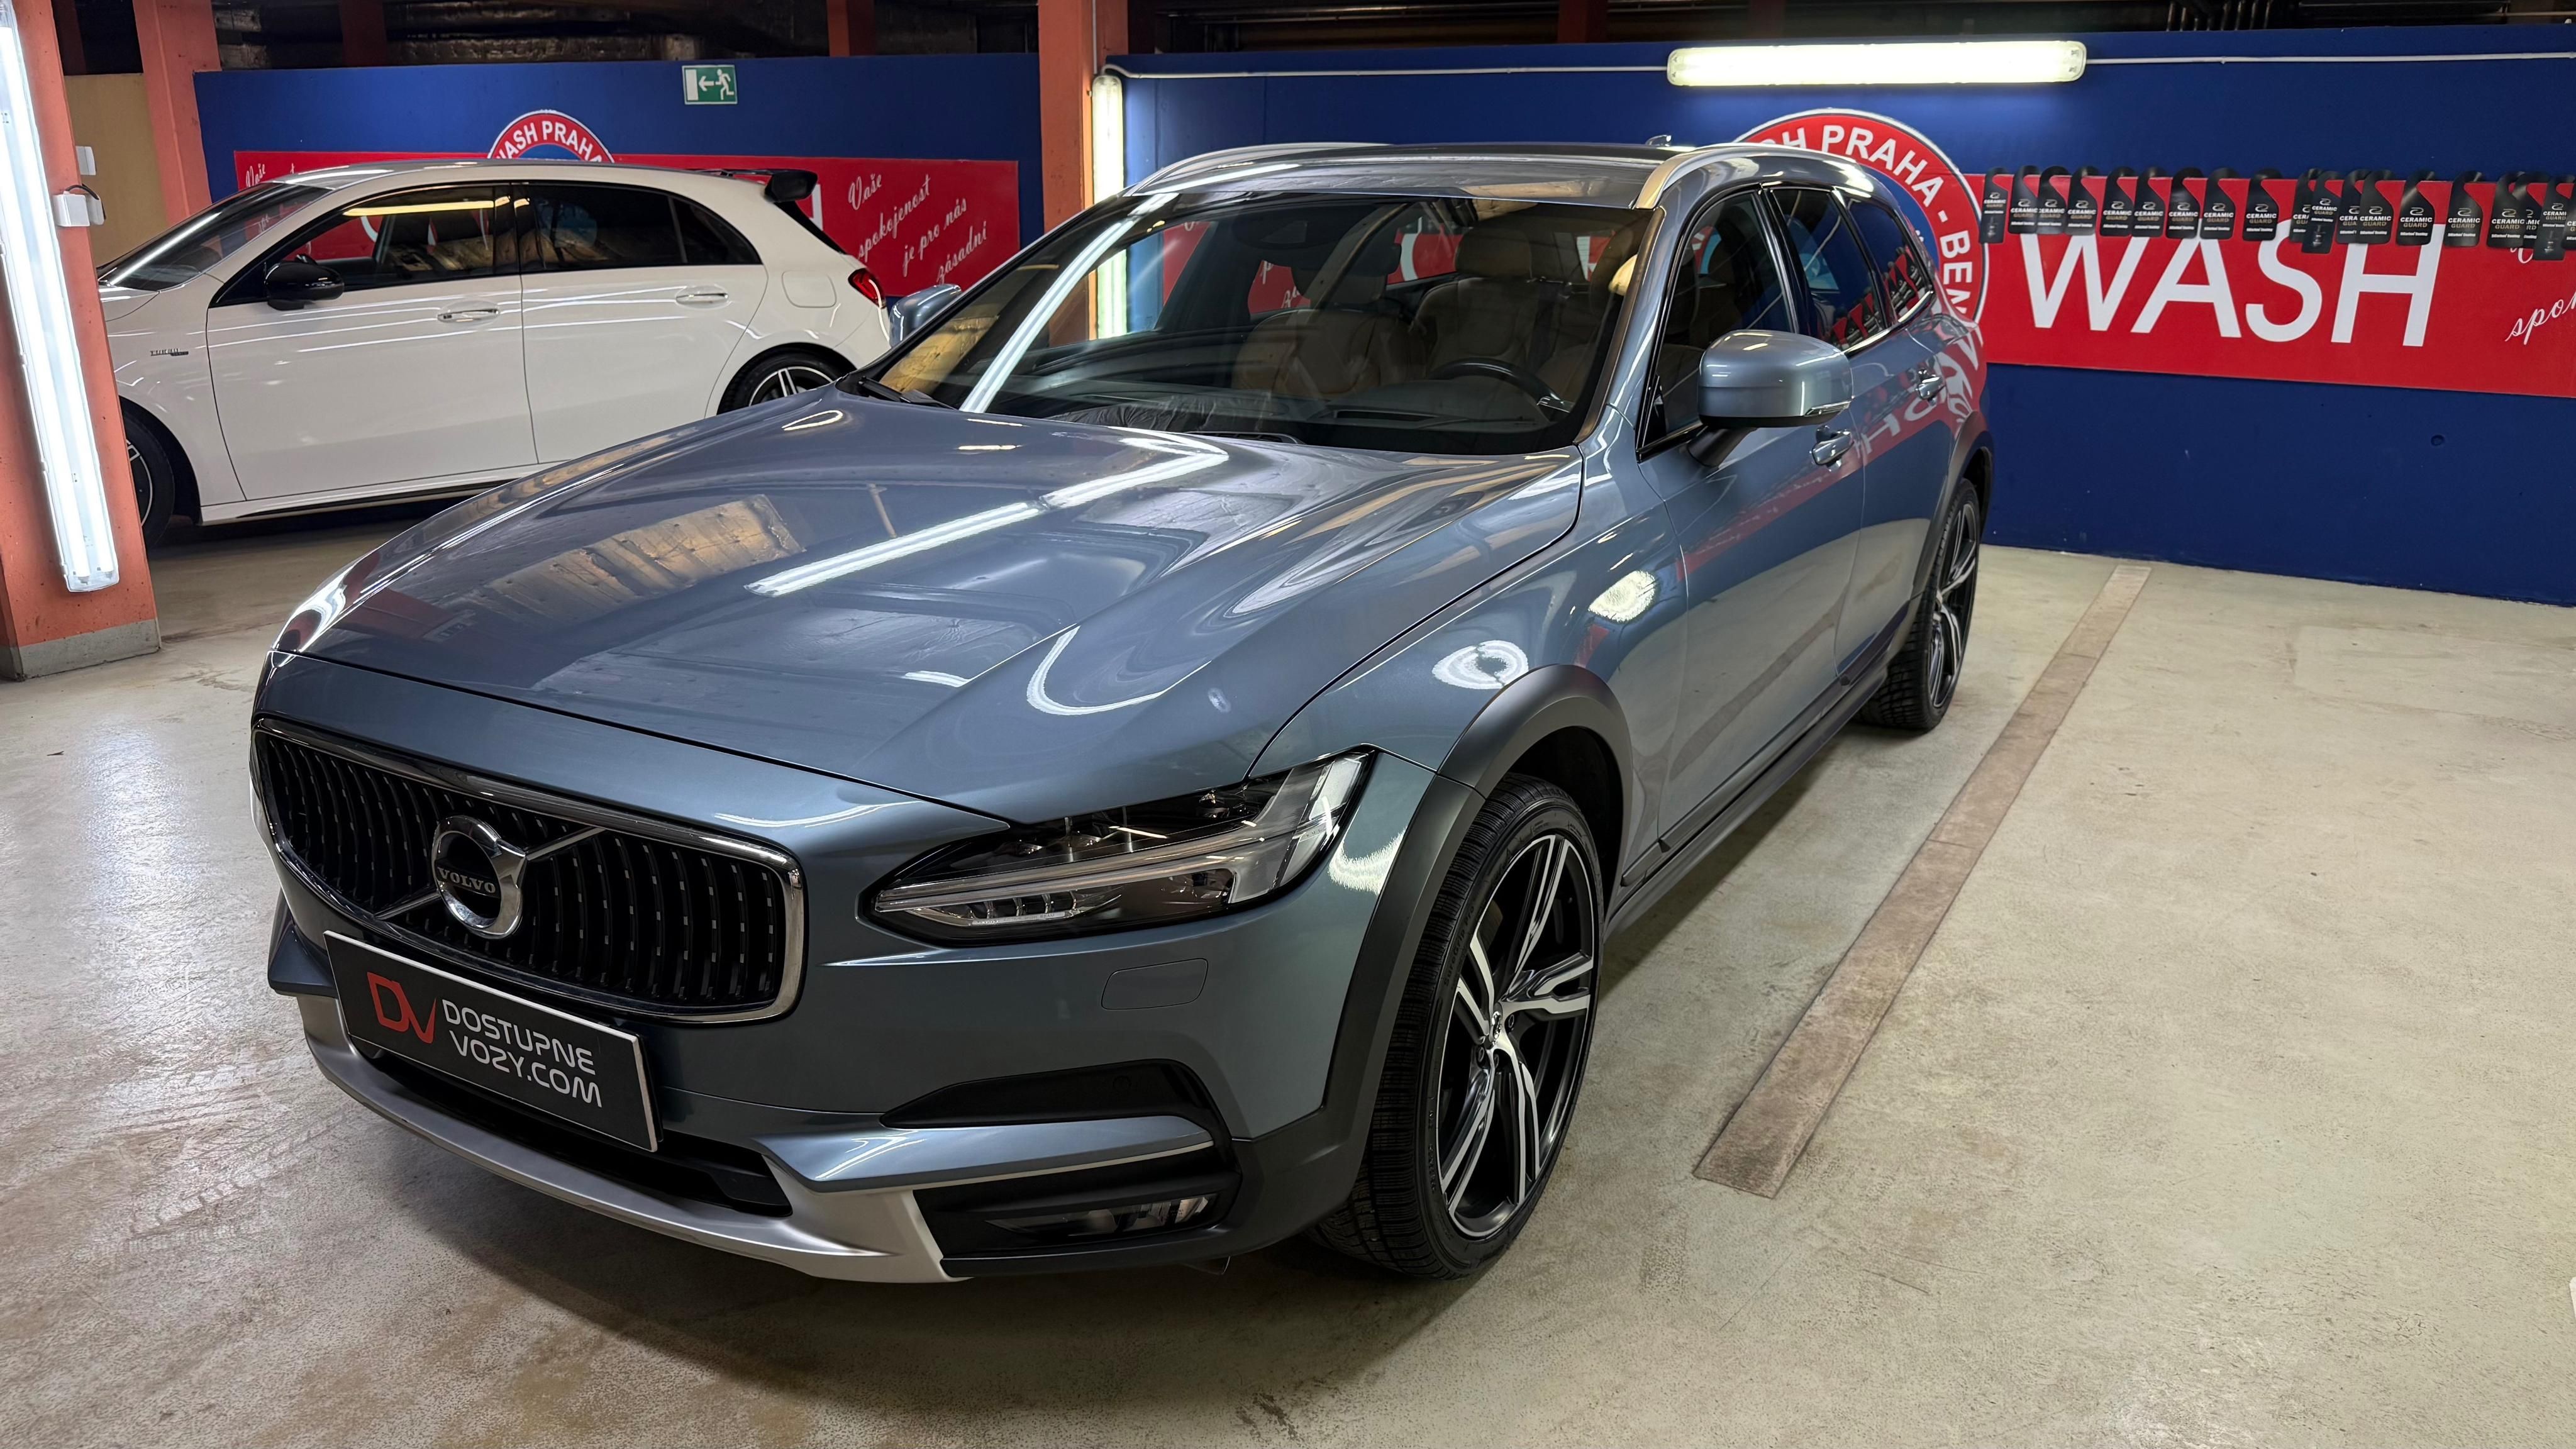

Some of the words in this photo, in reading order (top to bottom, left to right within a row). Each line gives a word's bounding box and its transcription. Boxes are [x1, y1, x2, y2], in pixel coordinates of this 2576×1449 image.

[848, 173, 882, 210] Vaše
[858, 174, 931, 263] spokojenost
[1821, 125, 1944, 208] PRAHA
[1940, 230, 1973, 314] BEN
[902, 244, 915, 277] je
[918, 224, 940, 260] pro
[943, 198, 967, 230] nás
[936, 220, 987, 284] zásadní
[2018, 219, 2443, 347] WASH
[437, 867, 496, 894] VOLVO
[441, 999, 596, 1076] DOSTUPNE
[448, 1030, 602, 1108] VOZY.COM
